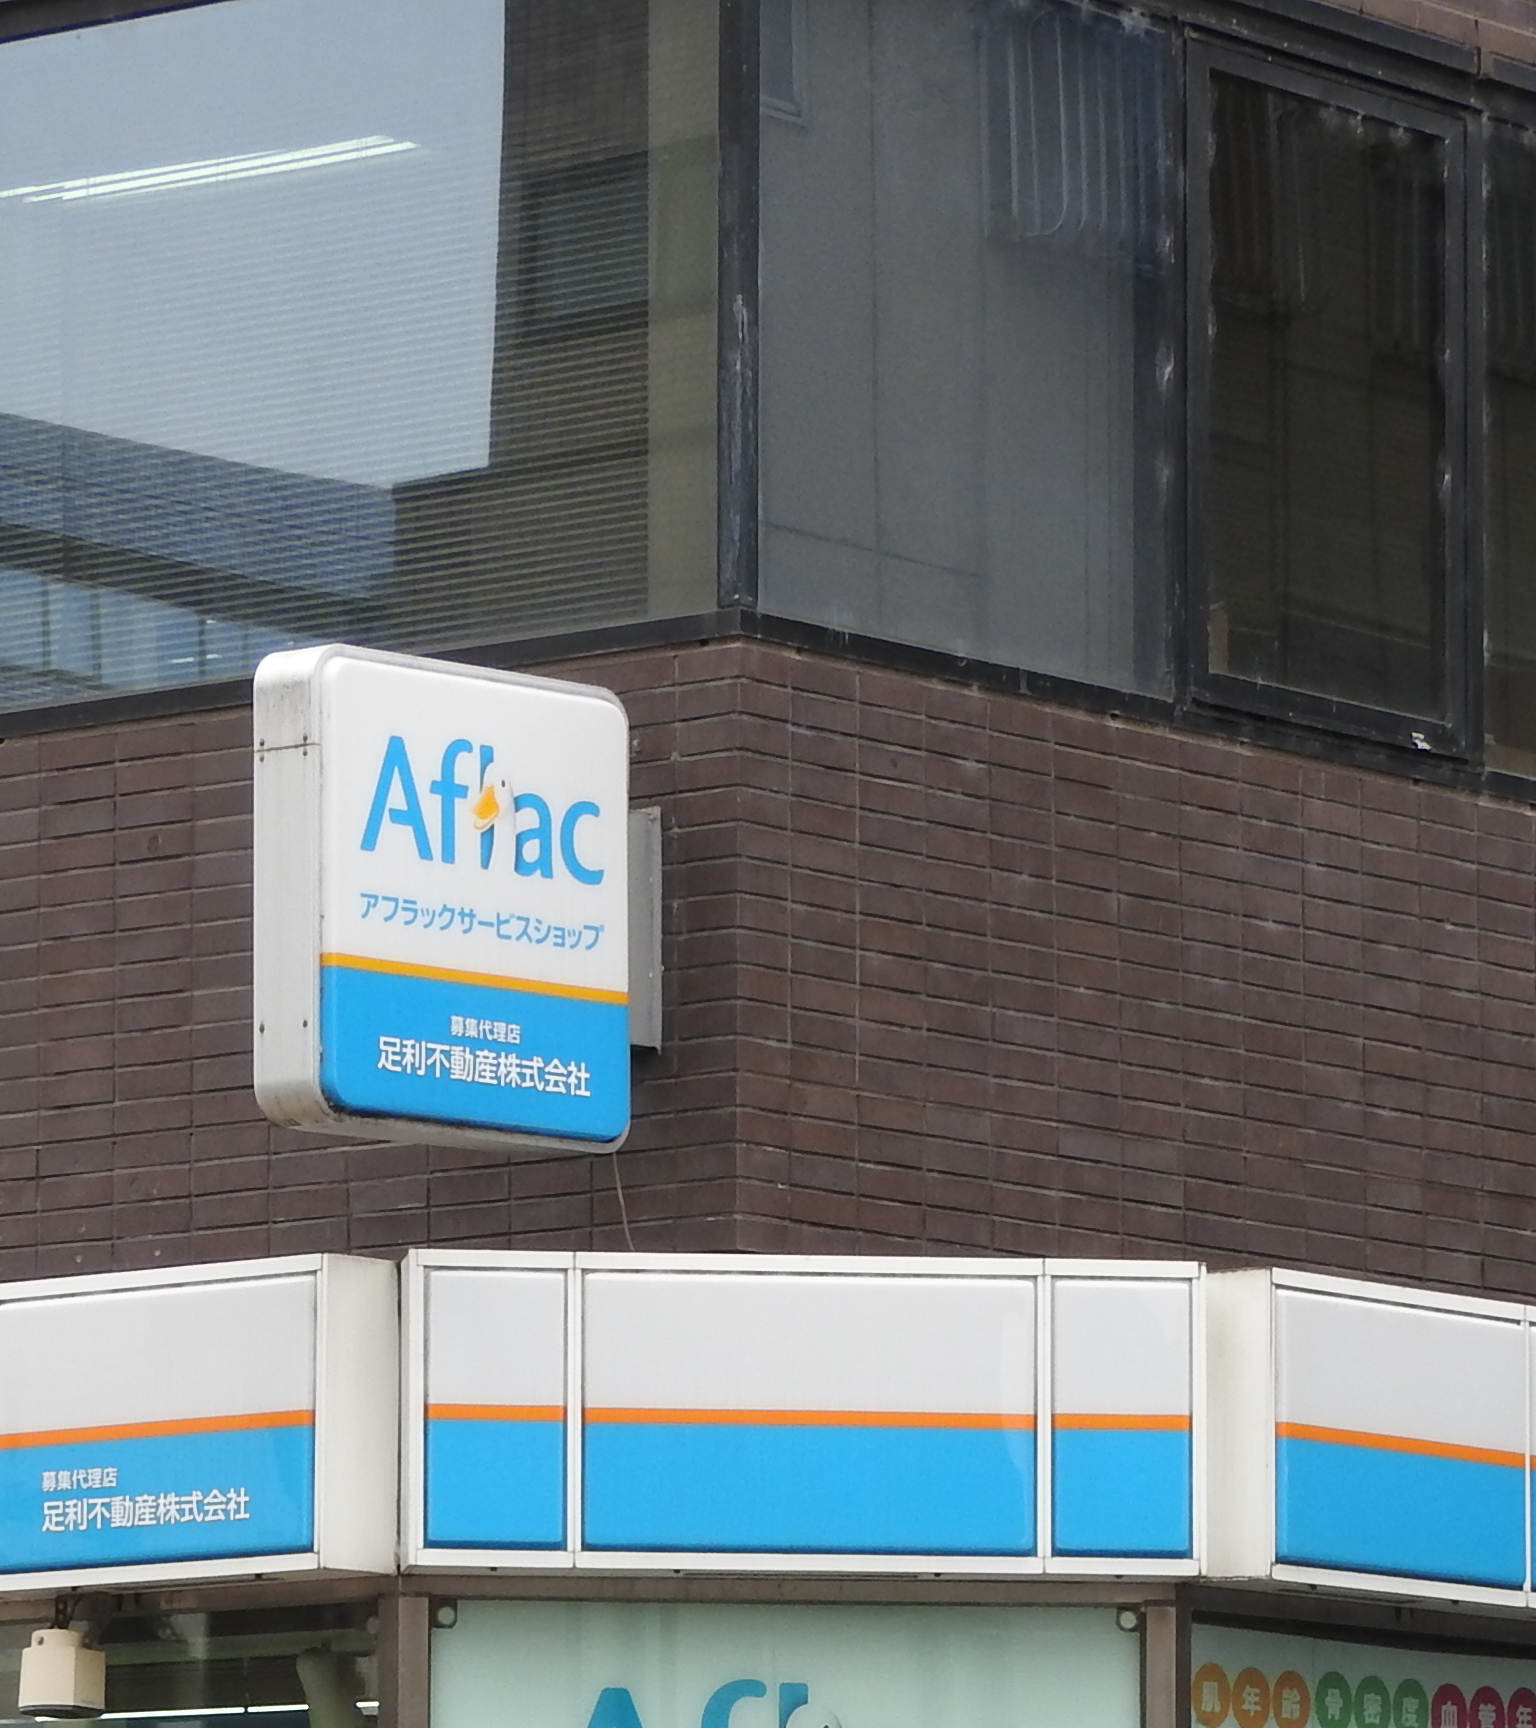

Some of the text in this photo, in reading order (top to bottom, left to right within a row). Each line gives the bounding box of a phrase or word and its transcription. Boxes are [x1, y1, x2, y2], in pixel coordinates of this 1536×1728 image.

[360, 735, 605, 885] Aflac
[360, 892, 605, 951] アフラックサービスショップ
[450, 1015, 522, 1045] 募集代理店
[377, 1035, 592, 1098] 足利不動産株式会社
[41, 1466, 119, 1492] 募集代理店
[41, 1486, 251, 1532] 足利不動産株式会社
